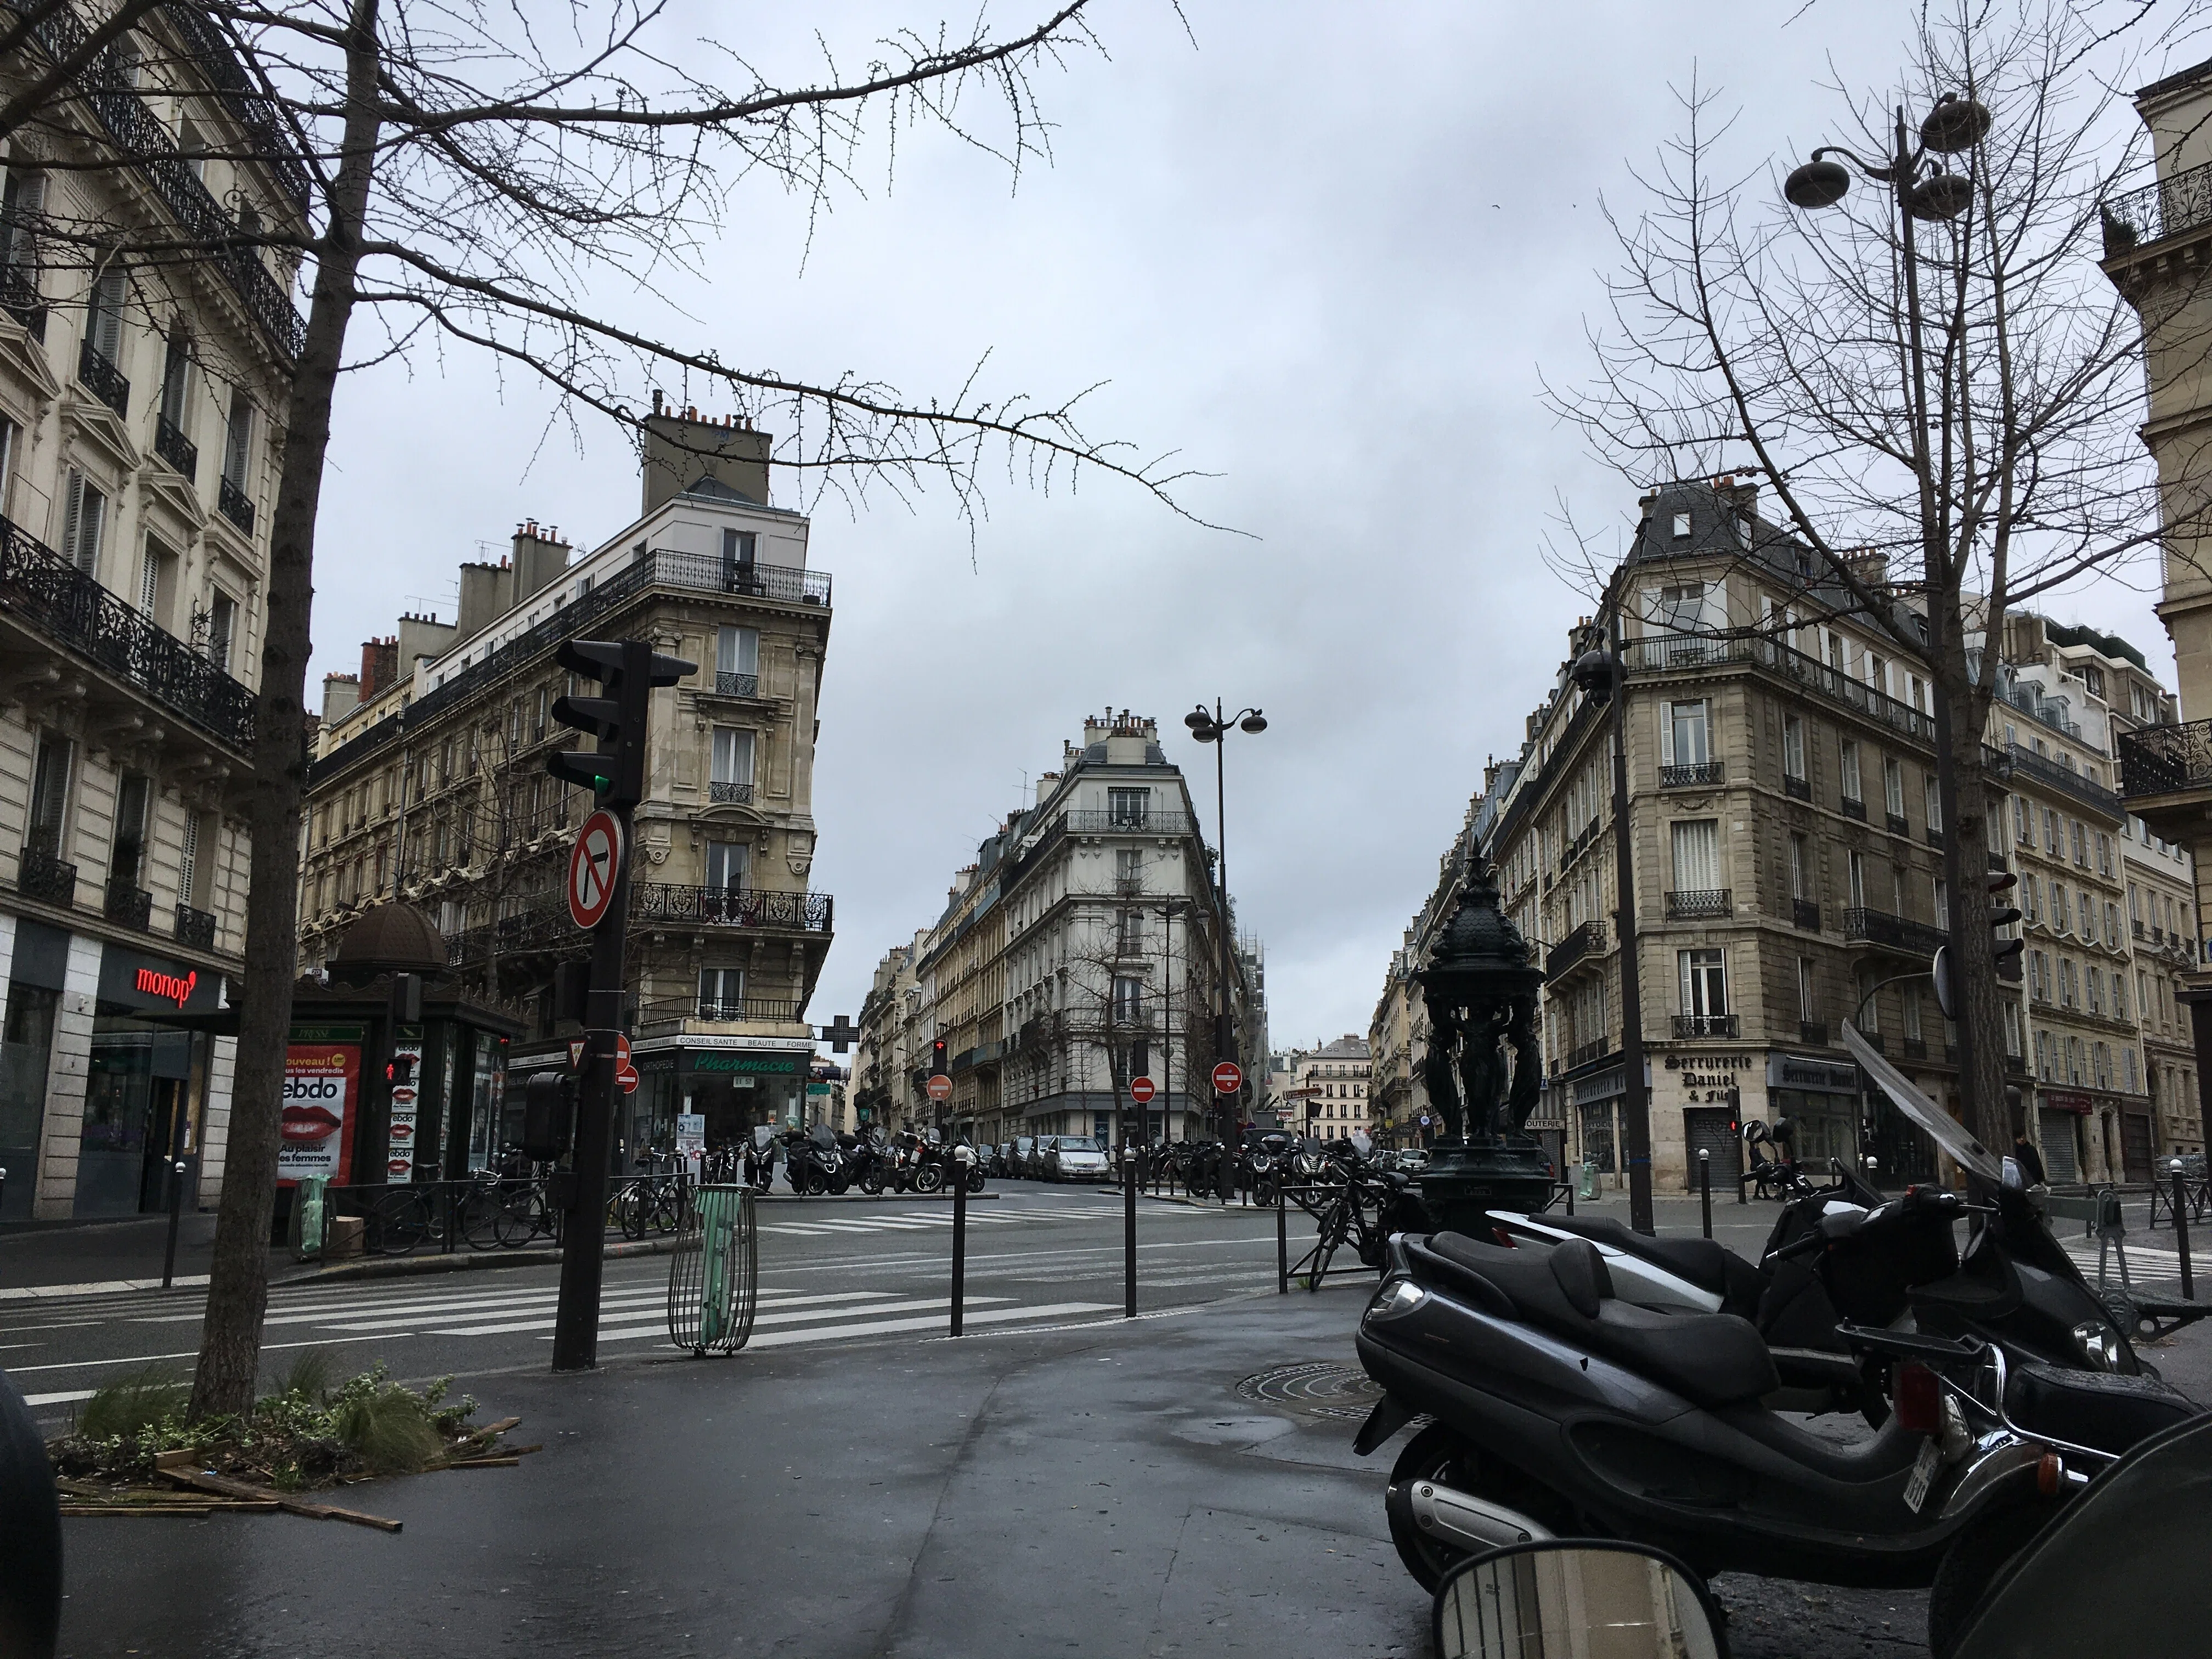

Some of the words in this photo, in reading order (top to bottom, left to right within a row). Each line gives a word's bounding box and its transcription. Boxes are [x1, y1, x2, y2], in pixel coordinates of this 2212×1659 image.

[694, 1050, 795, 1072] Pharmacie
[1681, 1071, 1736, 1086] Daniel
[283, 1077, 337, 1099] ebdo
[1689, 1090, 1699, 1102] &
[295, 1144, 326, 1154] plaisir
[390, 1149, 410, 1157] ebdo
[292, 1154, 331, 1162] femmes
